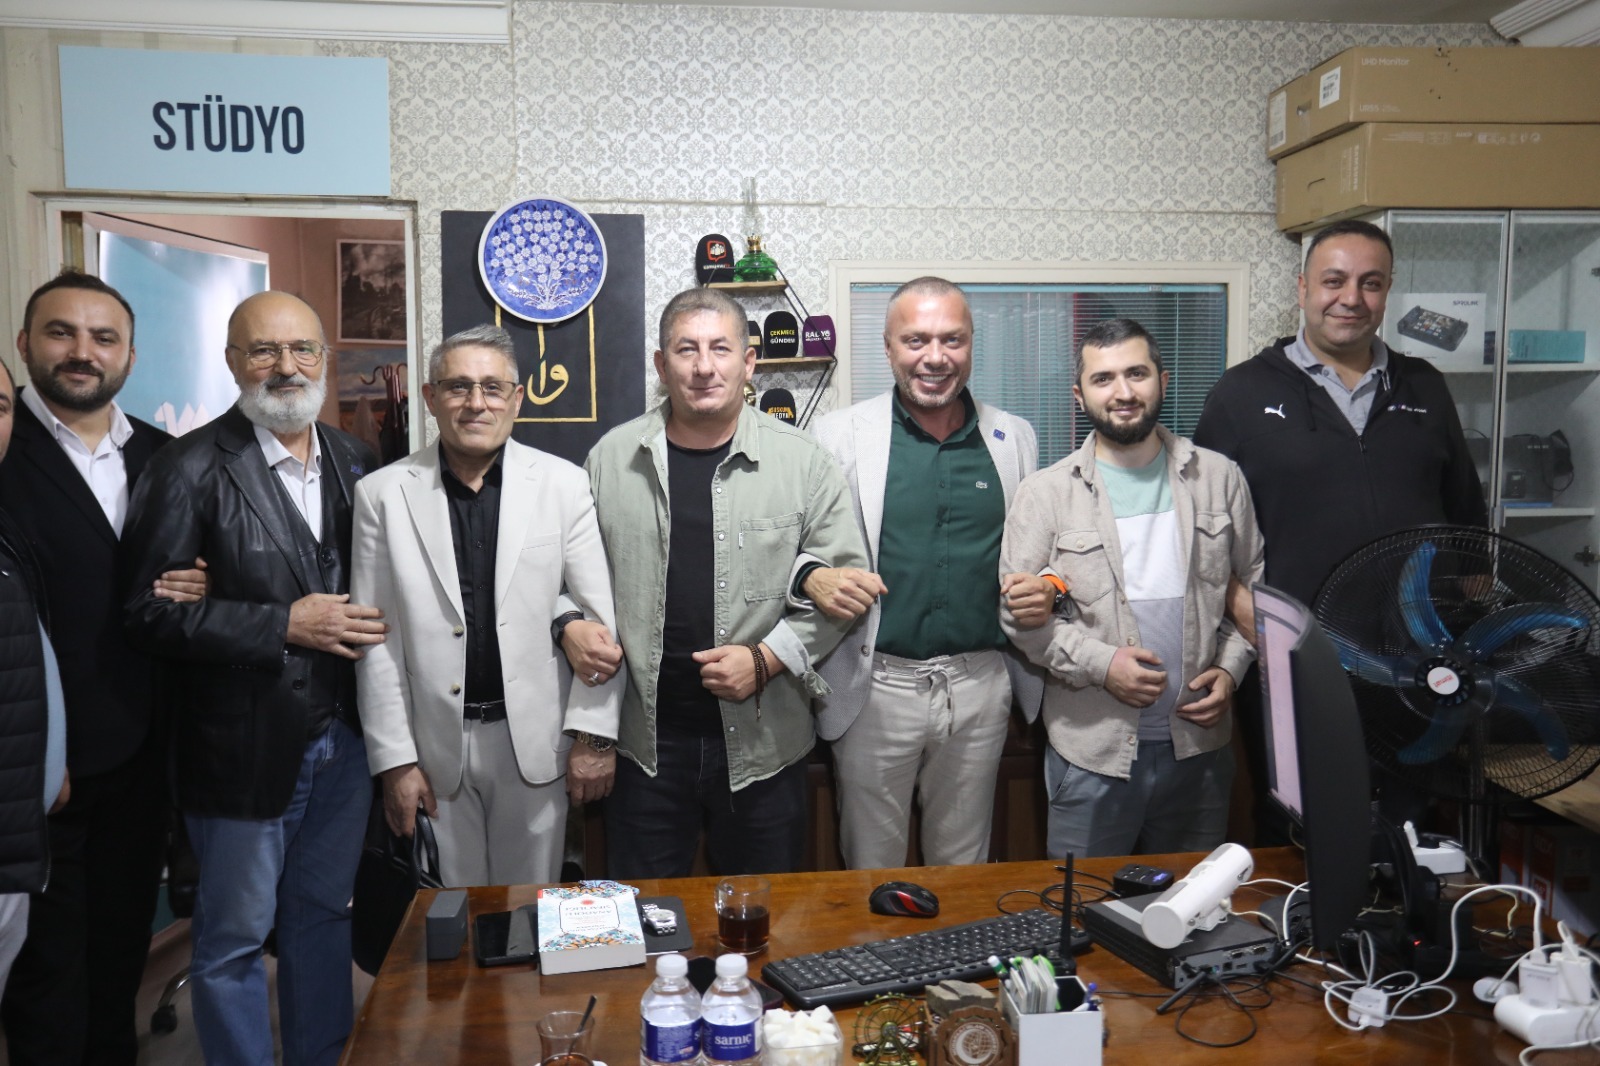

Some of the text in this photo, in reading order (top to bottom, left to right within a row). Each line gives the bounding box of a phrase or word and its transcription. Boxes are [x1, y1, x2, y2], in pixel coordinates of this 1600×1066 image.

[1379, 57, 1409, 66] Monitor
[152, 94, 305, 154] STÜDYO
[769, 336, 796, 344] GÜNDEM
